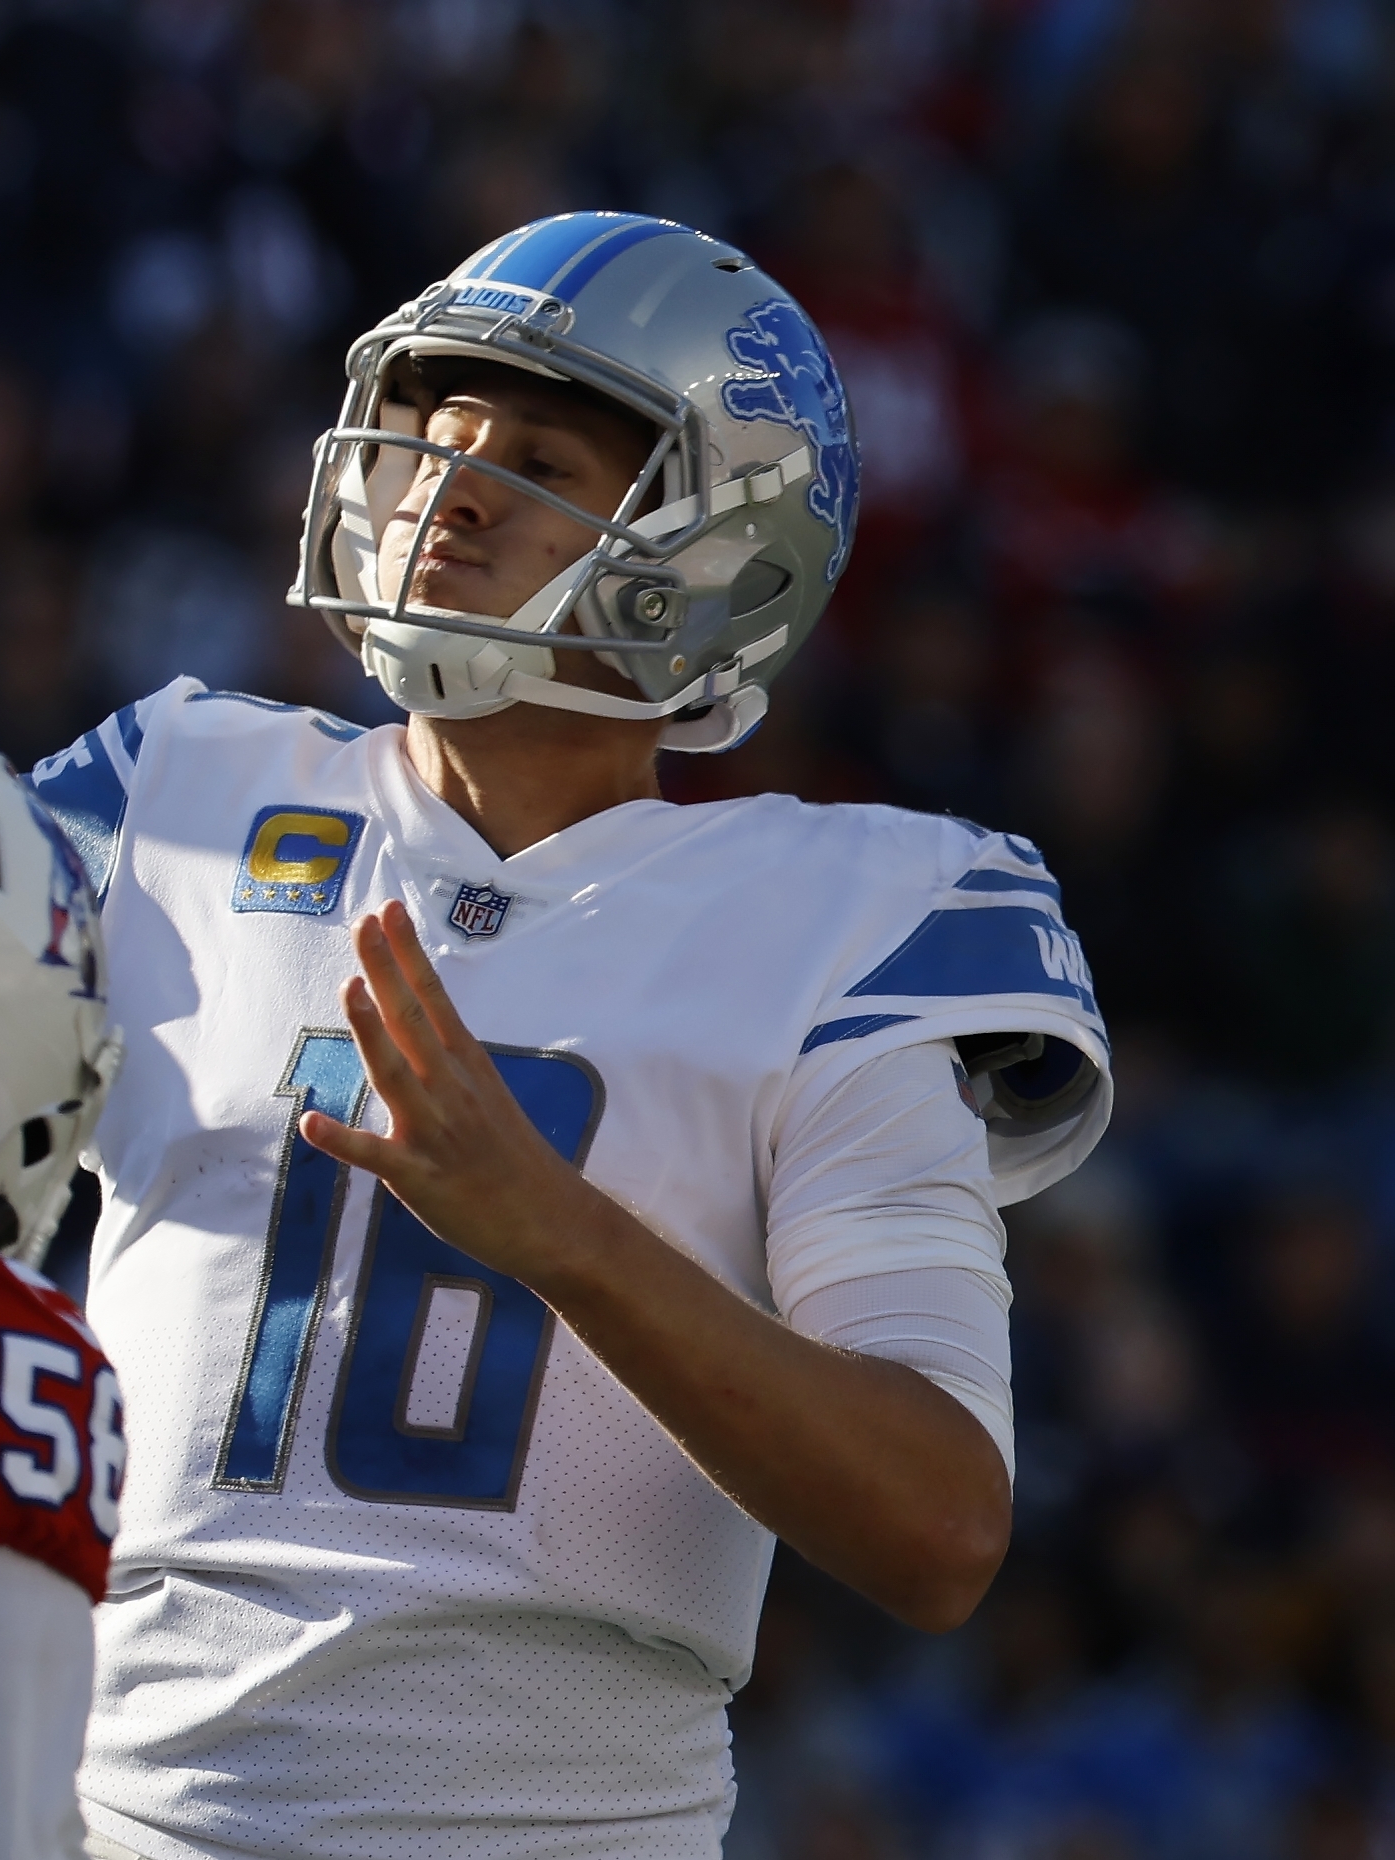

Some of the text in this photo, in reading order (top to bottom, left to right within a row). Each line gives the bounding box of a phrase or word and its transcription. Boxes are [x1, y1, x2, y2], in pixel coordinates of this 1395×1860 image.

[452, 286, 535, 315] LIONS
[248, 812, 349, 886] C
[452, 900, 496, 932] NFL
